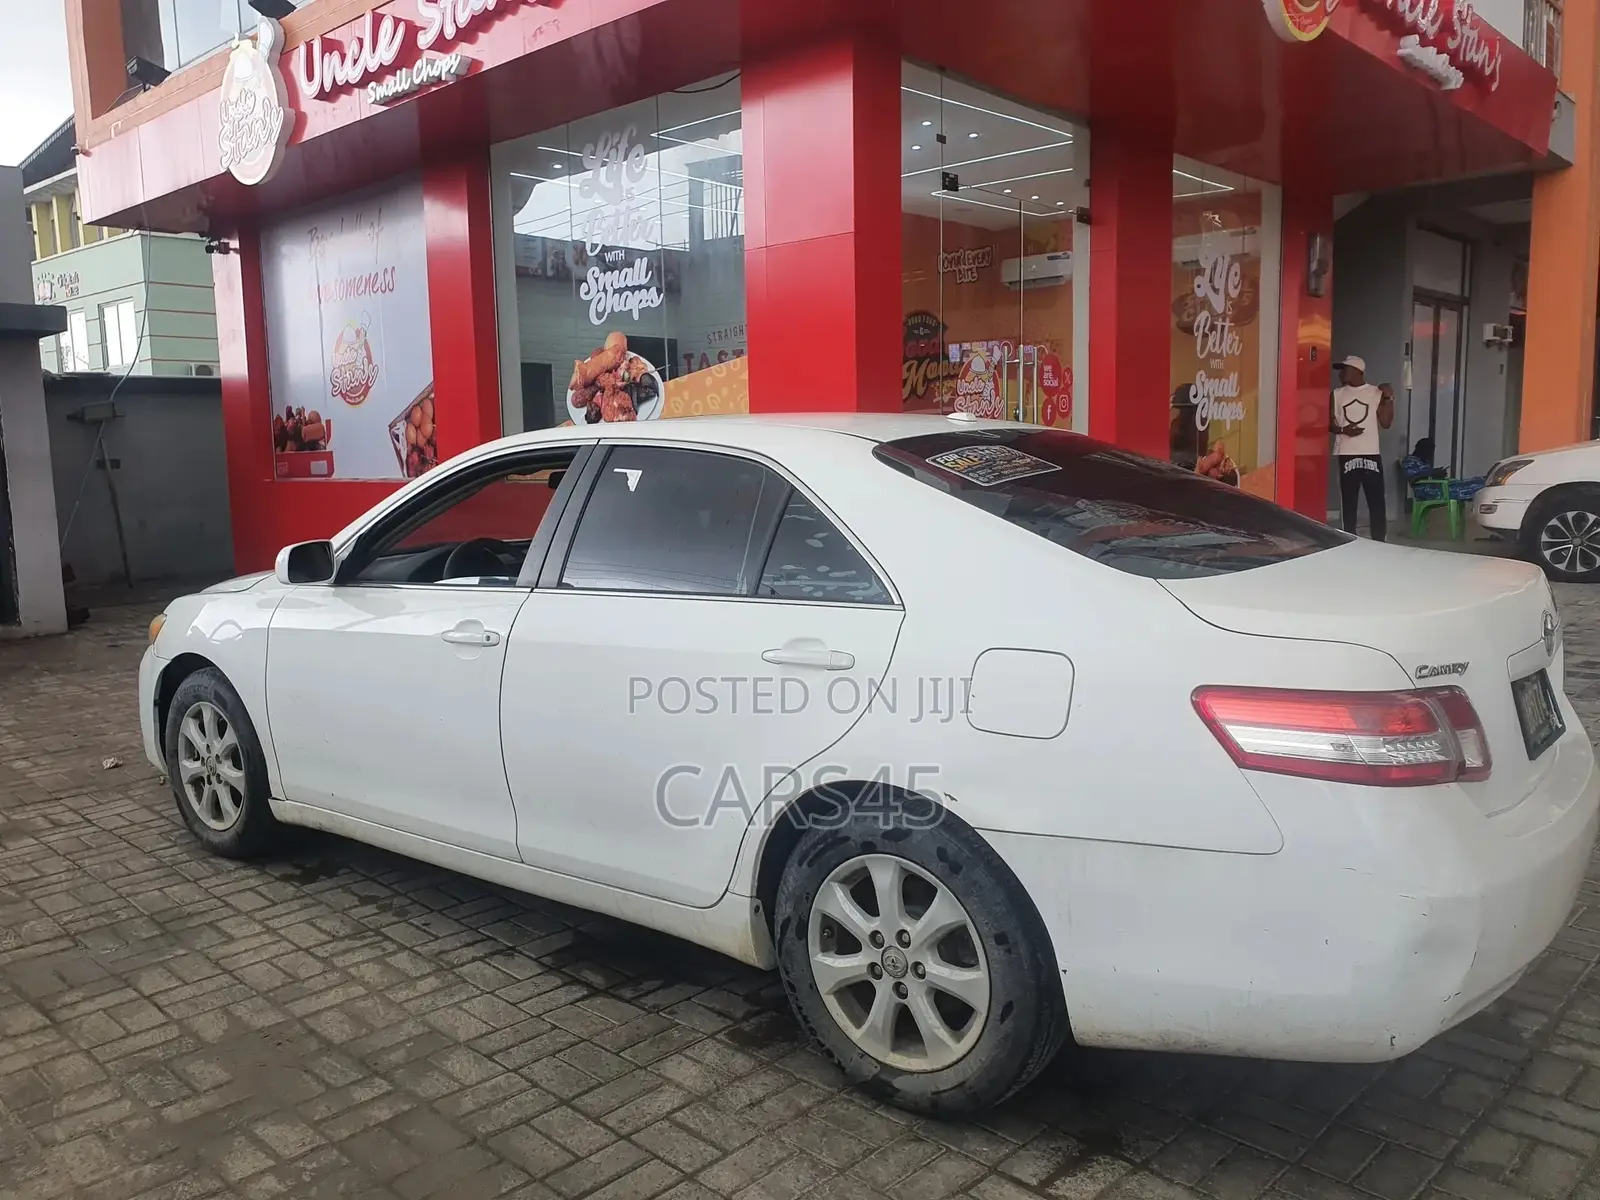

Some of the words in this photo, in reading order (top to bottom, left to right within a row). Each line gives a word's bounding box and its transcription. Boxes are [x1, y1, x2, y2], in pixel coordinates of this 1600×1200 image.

[299, 9, 406, 99] Uncle
[367, 69, 411, 105] Small
[412, 54, 462, 83] Chops
[604, 250, 626, 263] WITH
[580, 257, 653, 301] Small
[589, 286, 665, 326] Chops
[706, 323, 748, 346] STRAIGH
[1193, 310, 1243, 359] Better
[1043, 364, 1053, 372] we
[1209, 357, 1225, 370] WITH
[1189, 369, 1241, 405] Small
[1195, 396, 1247, 432] Chops
[935, 453, 961, 465] FOR
